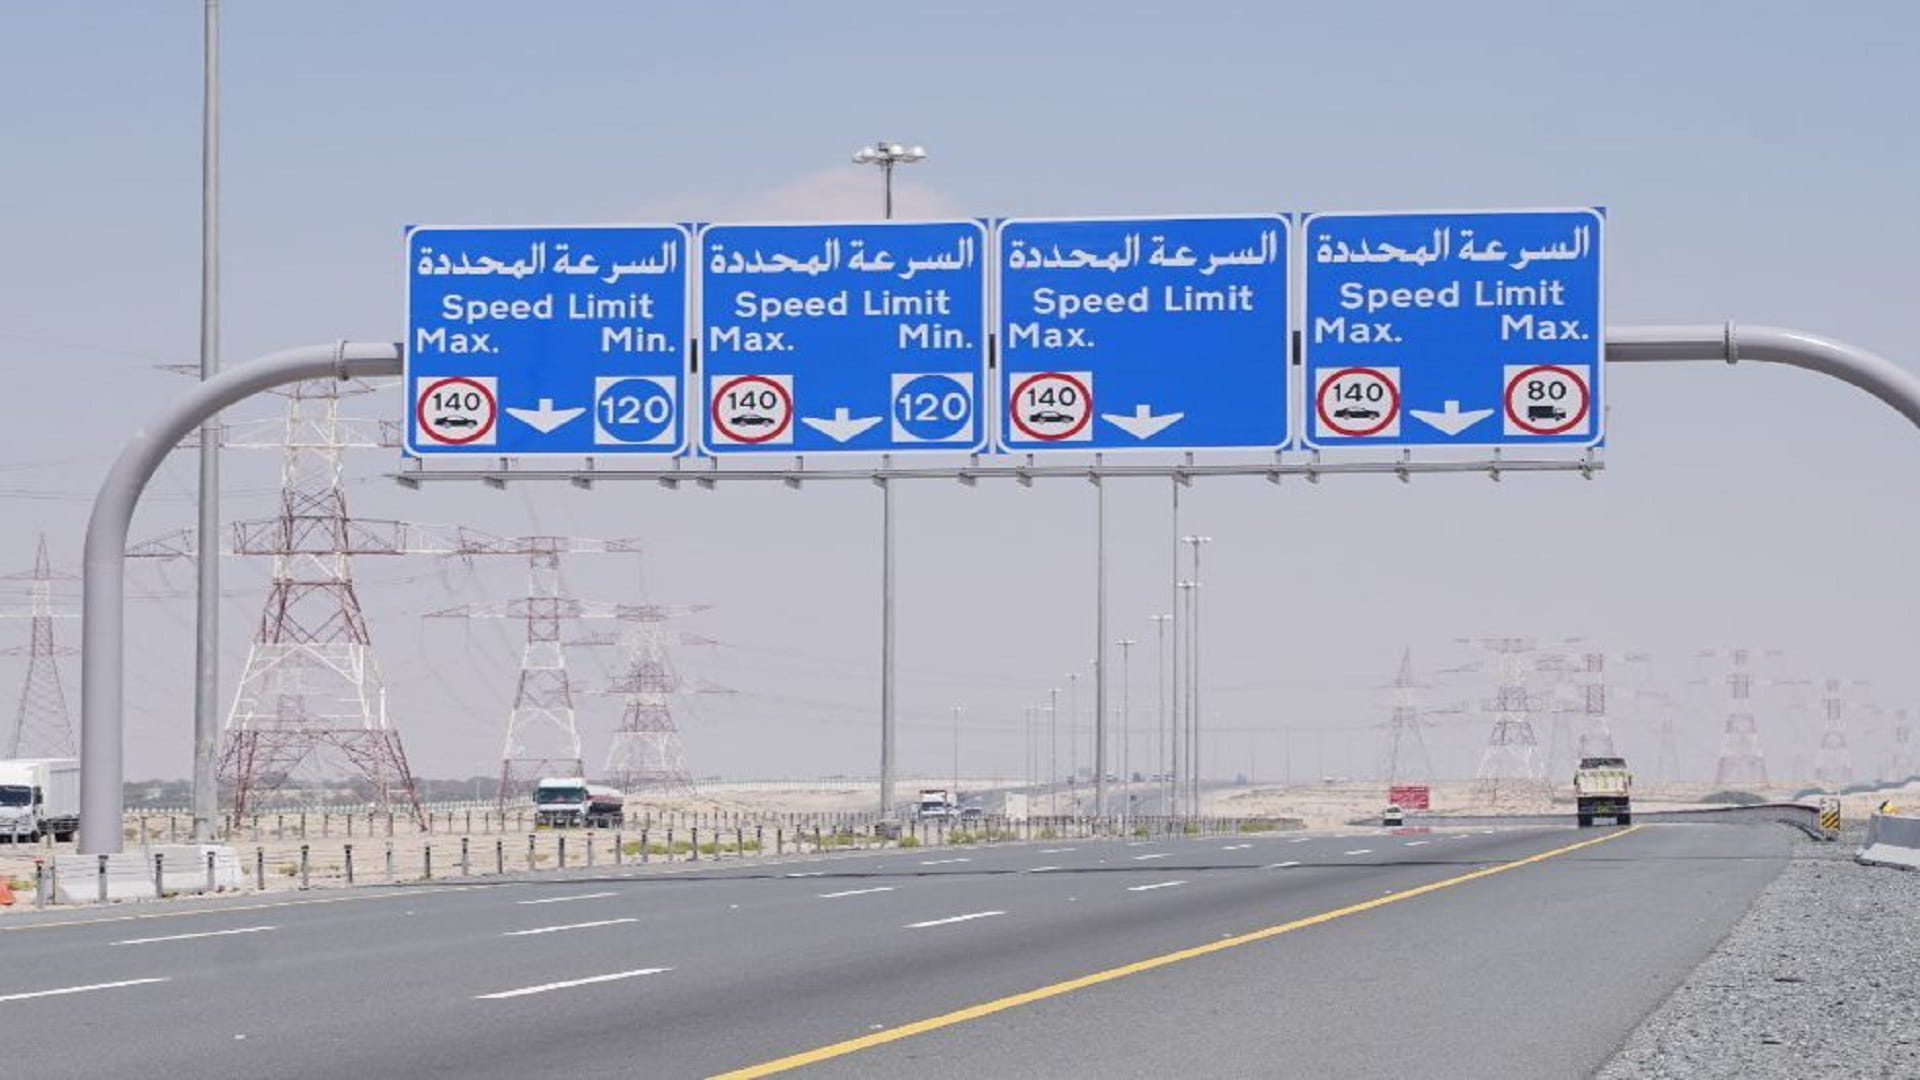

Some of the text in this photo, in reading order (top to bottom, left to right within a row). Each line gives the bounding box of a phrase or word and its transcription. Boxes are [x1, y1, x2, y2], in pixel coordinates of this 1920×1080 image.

[711, 237, 973, 279] السرعة المحددة
[1010, 231, 1276, 274] السرعة المحددة
[1318, 226, 1589, 269] السرعة المحددة
[418, 242, 676, 283] السرعة المحددة
[443, 295, 652, 322] Speed Limit
[736, 290, 949, 320] Speed Limit
[1034, 286, 1252, 317] Speed Limit
[1341, 281, 1563, 312] Speed Limit
[603, 327, 674, 351] Min.
[711, 327, 793, 351] Max.
[900, 324, 971, 348] Min.
[1010, 323, 1093, 347] Max.
[1316, 318, 1401, 342] Max.
[1502, 315, 1588, 339] Max.
[418, 328, 497, 353] Max.
[434, 393, 480, 410] 140
[729, 391, 776, 409] 140
[1029, 387, 1076, 406] 140
[1334, 383, 1383, 401] 140
[1529, 381, 1566, 400] 80
[602, 396, 669, 424] 120
[899, 393, 967, 422] 120
